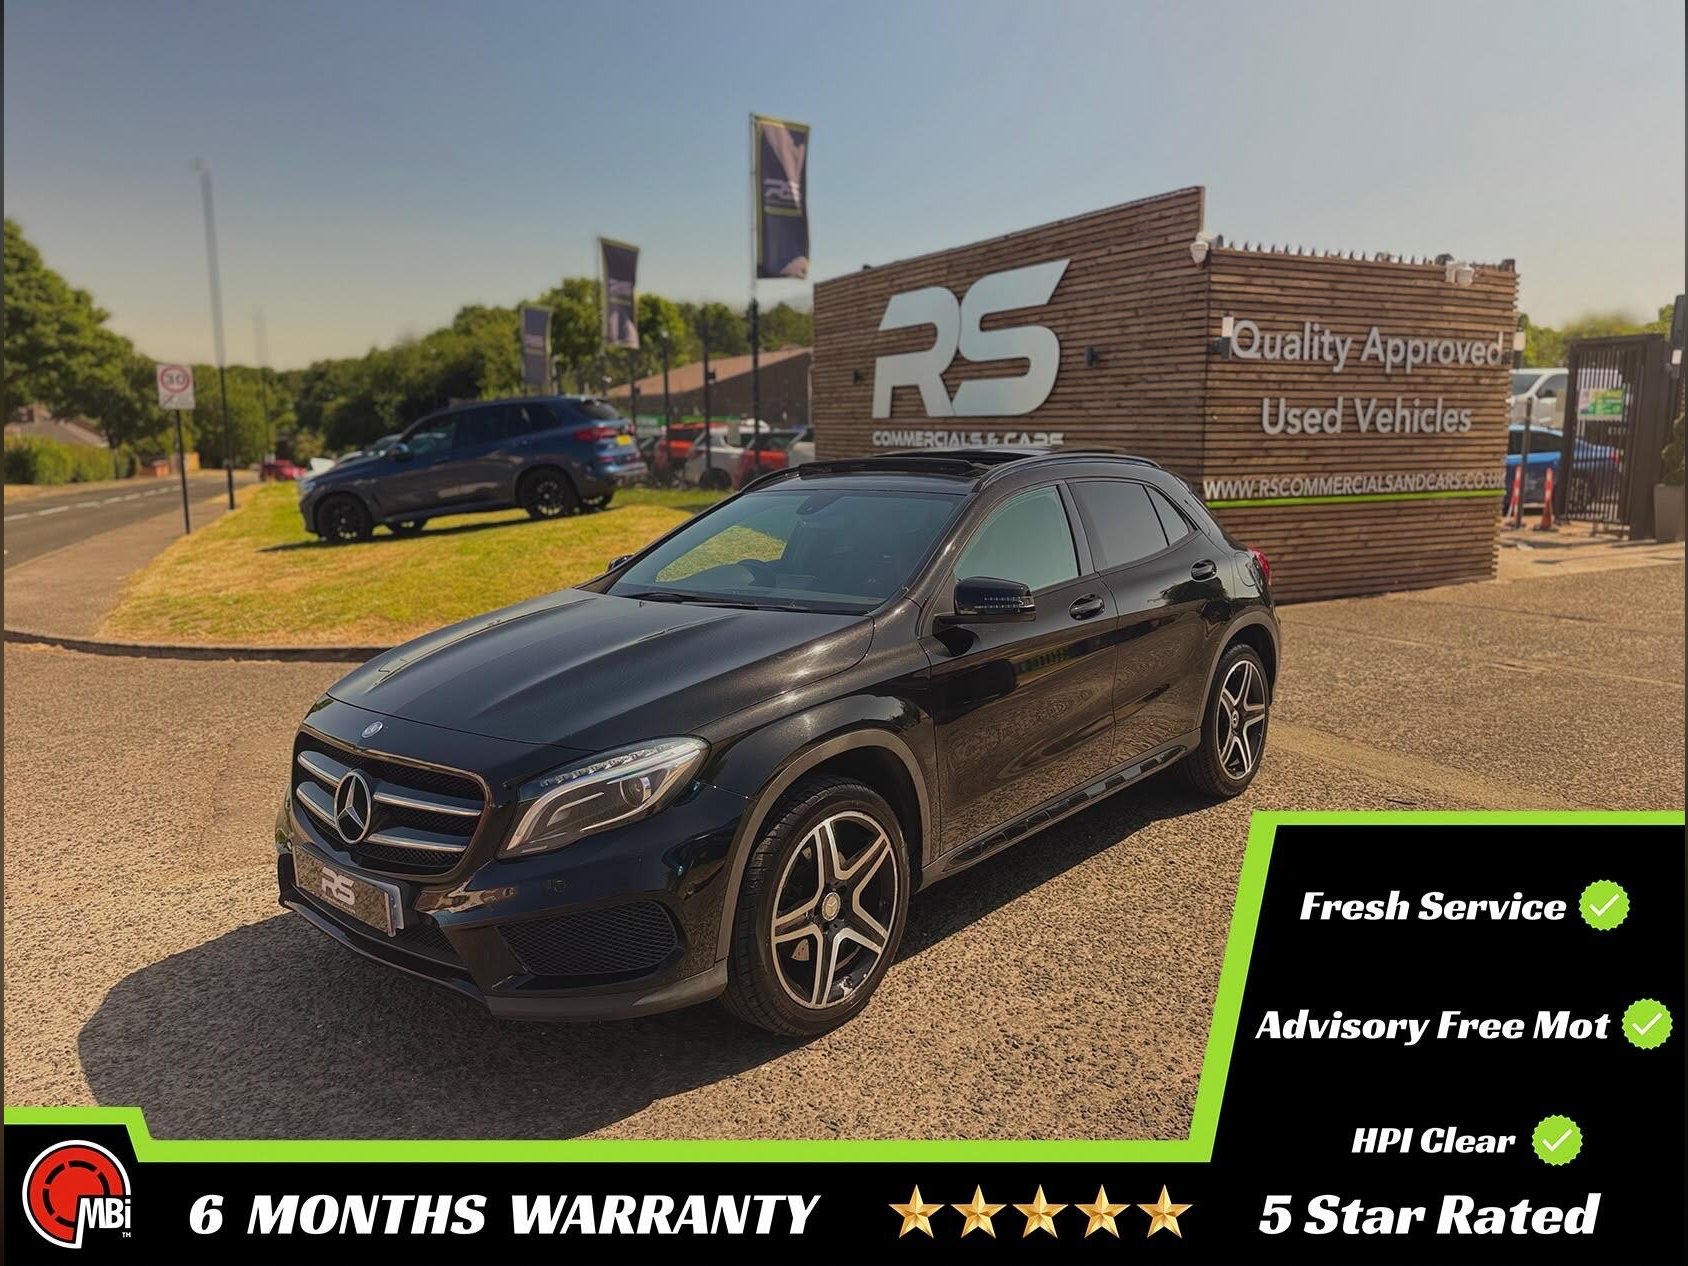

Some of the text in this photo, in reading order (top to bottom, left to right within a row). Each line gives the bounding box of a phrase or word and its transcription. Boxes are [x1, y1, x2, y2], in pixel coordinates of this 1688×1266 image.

[872, 259, 1071, 418] RS
[1231, 320, 1504, 374] Quality Approved
[165, 373, 186, 386] 30
[1261, 397, 1473, 435] Used Vehicles
[872, 430, 983, 448] COMMERCIALS
[986, 432, 1000, 447] &
[321, 866, 356, 906] RS
